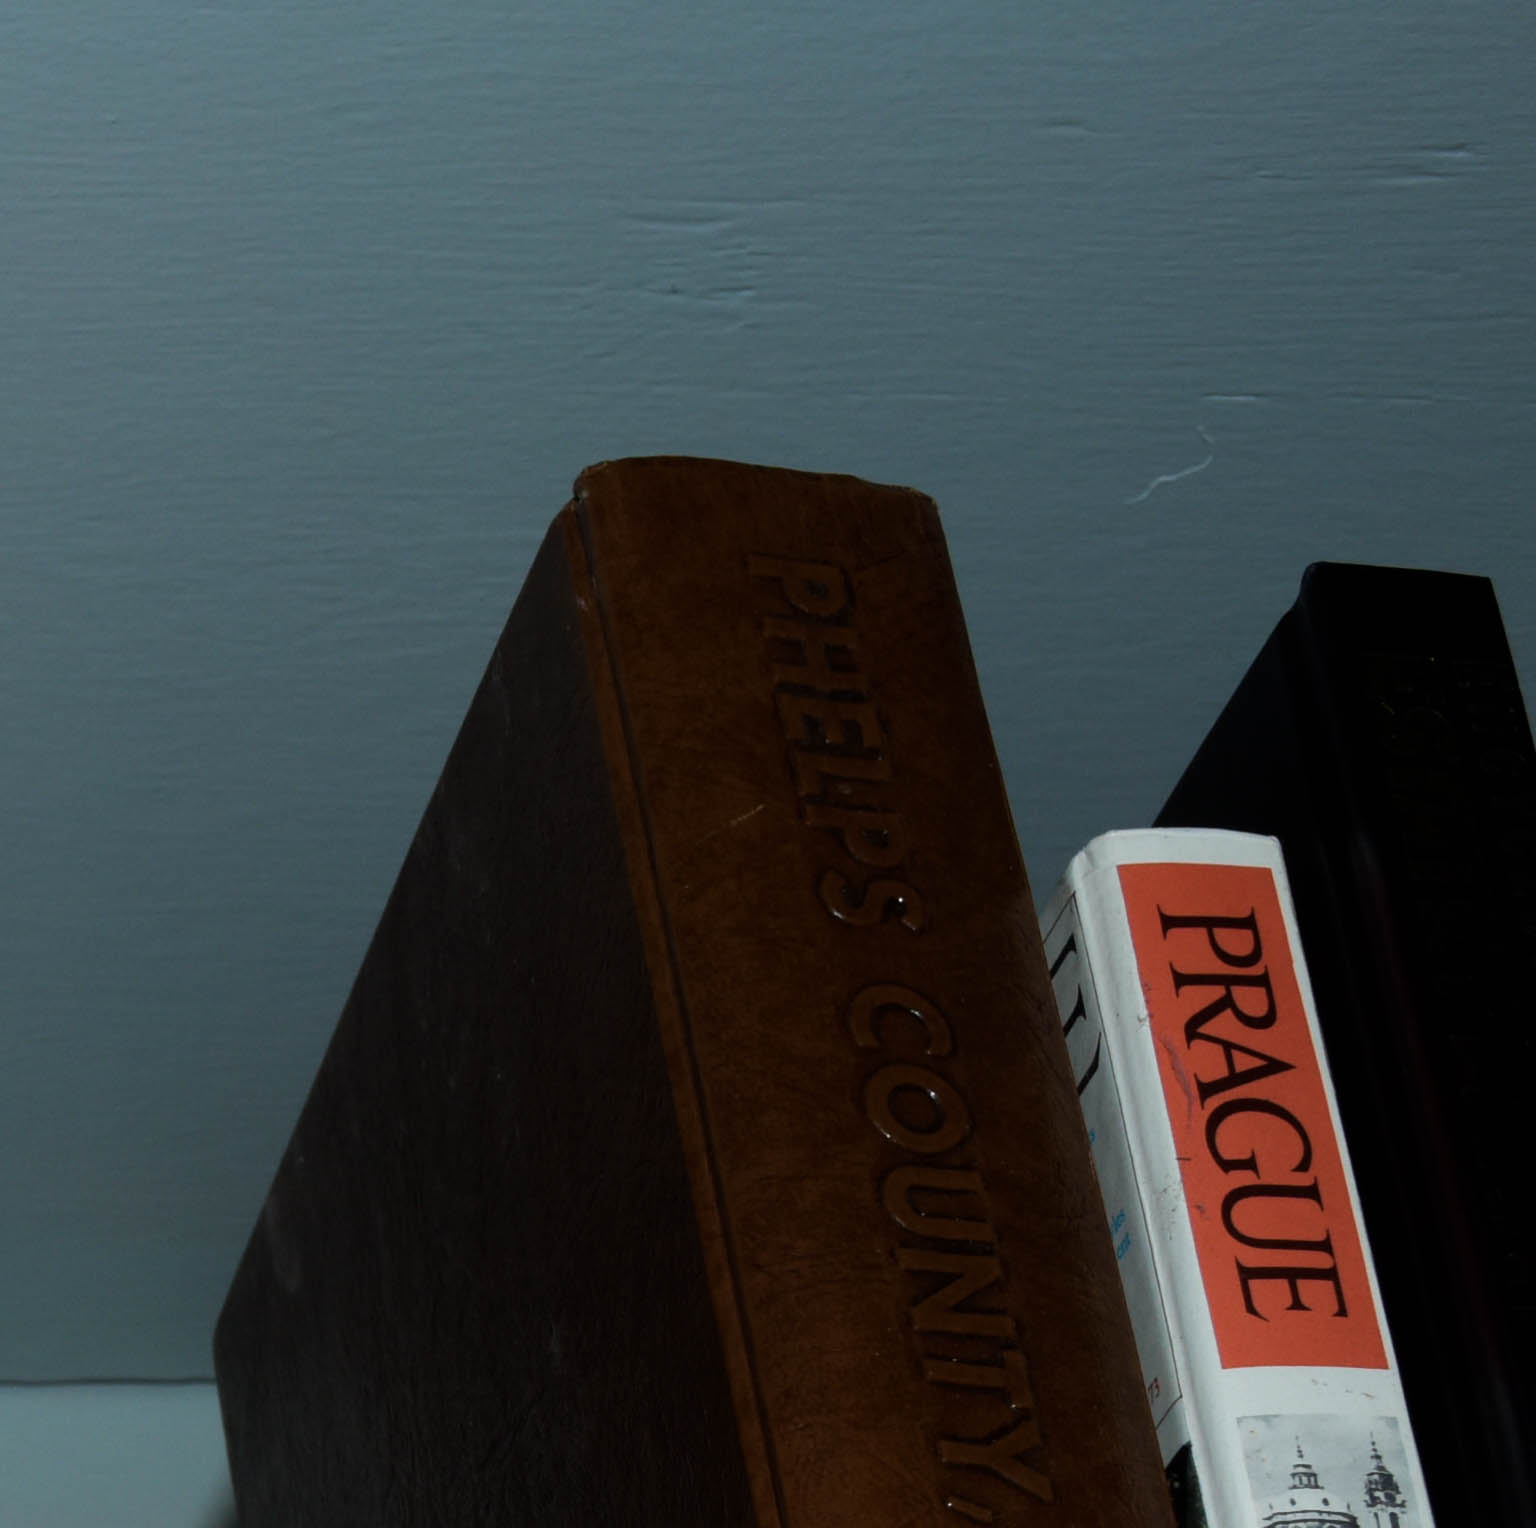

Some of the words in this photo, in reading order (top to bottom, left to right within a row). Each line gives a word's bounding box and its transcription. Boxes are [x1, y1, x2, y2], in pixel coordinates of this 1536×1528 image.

[745, 552, 927, 938] PHELPS
[847, 982, 1052, 1524] COUNTY,
[1156, 903, 1348, 1323] PRAGUE
